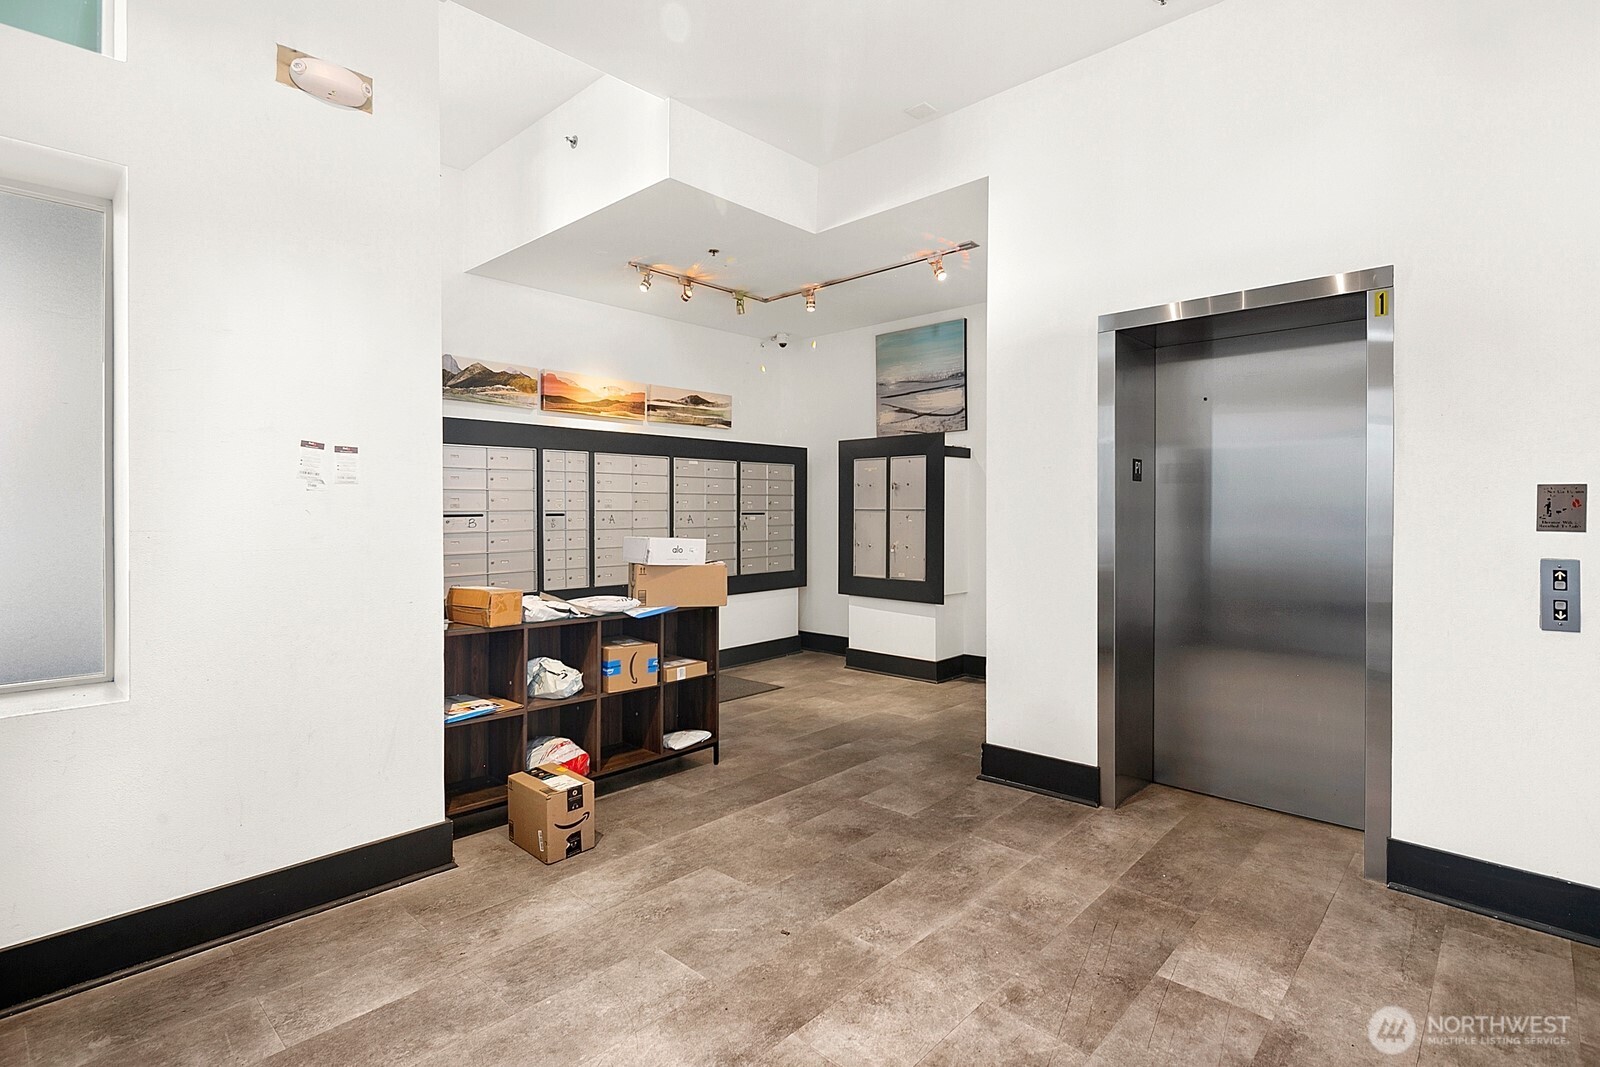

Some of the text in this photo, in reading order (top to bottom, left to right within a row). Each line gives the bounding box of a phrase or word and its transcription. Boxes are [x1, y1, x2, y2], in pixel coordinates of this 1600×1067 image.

[1379, 292, 1384, 315] 1
[468, 518, 477, 529] B
[609, 514, 616, 524] A
[687, 514, 694, 524] A
[742, 522, 748, 531] A
[672, 545, 684, 553] alo
